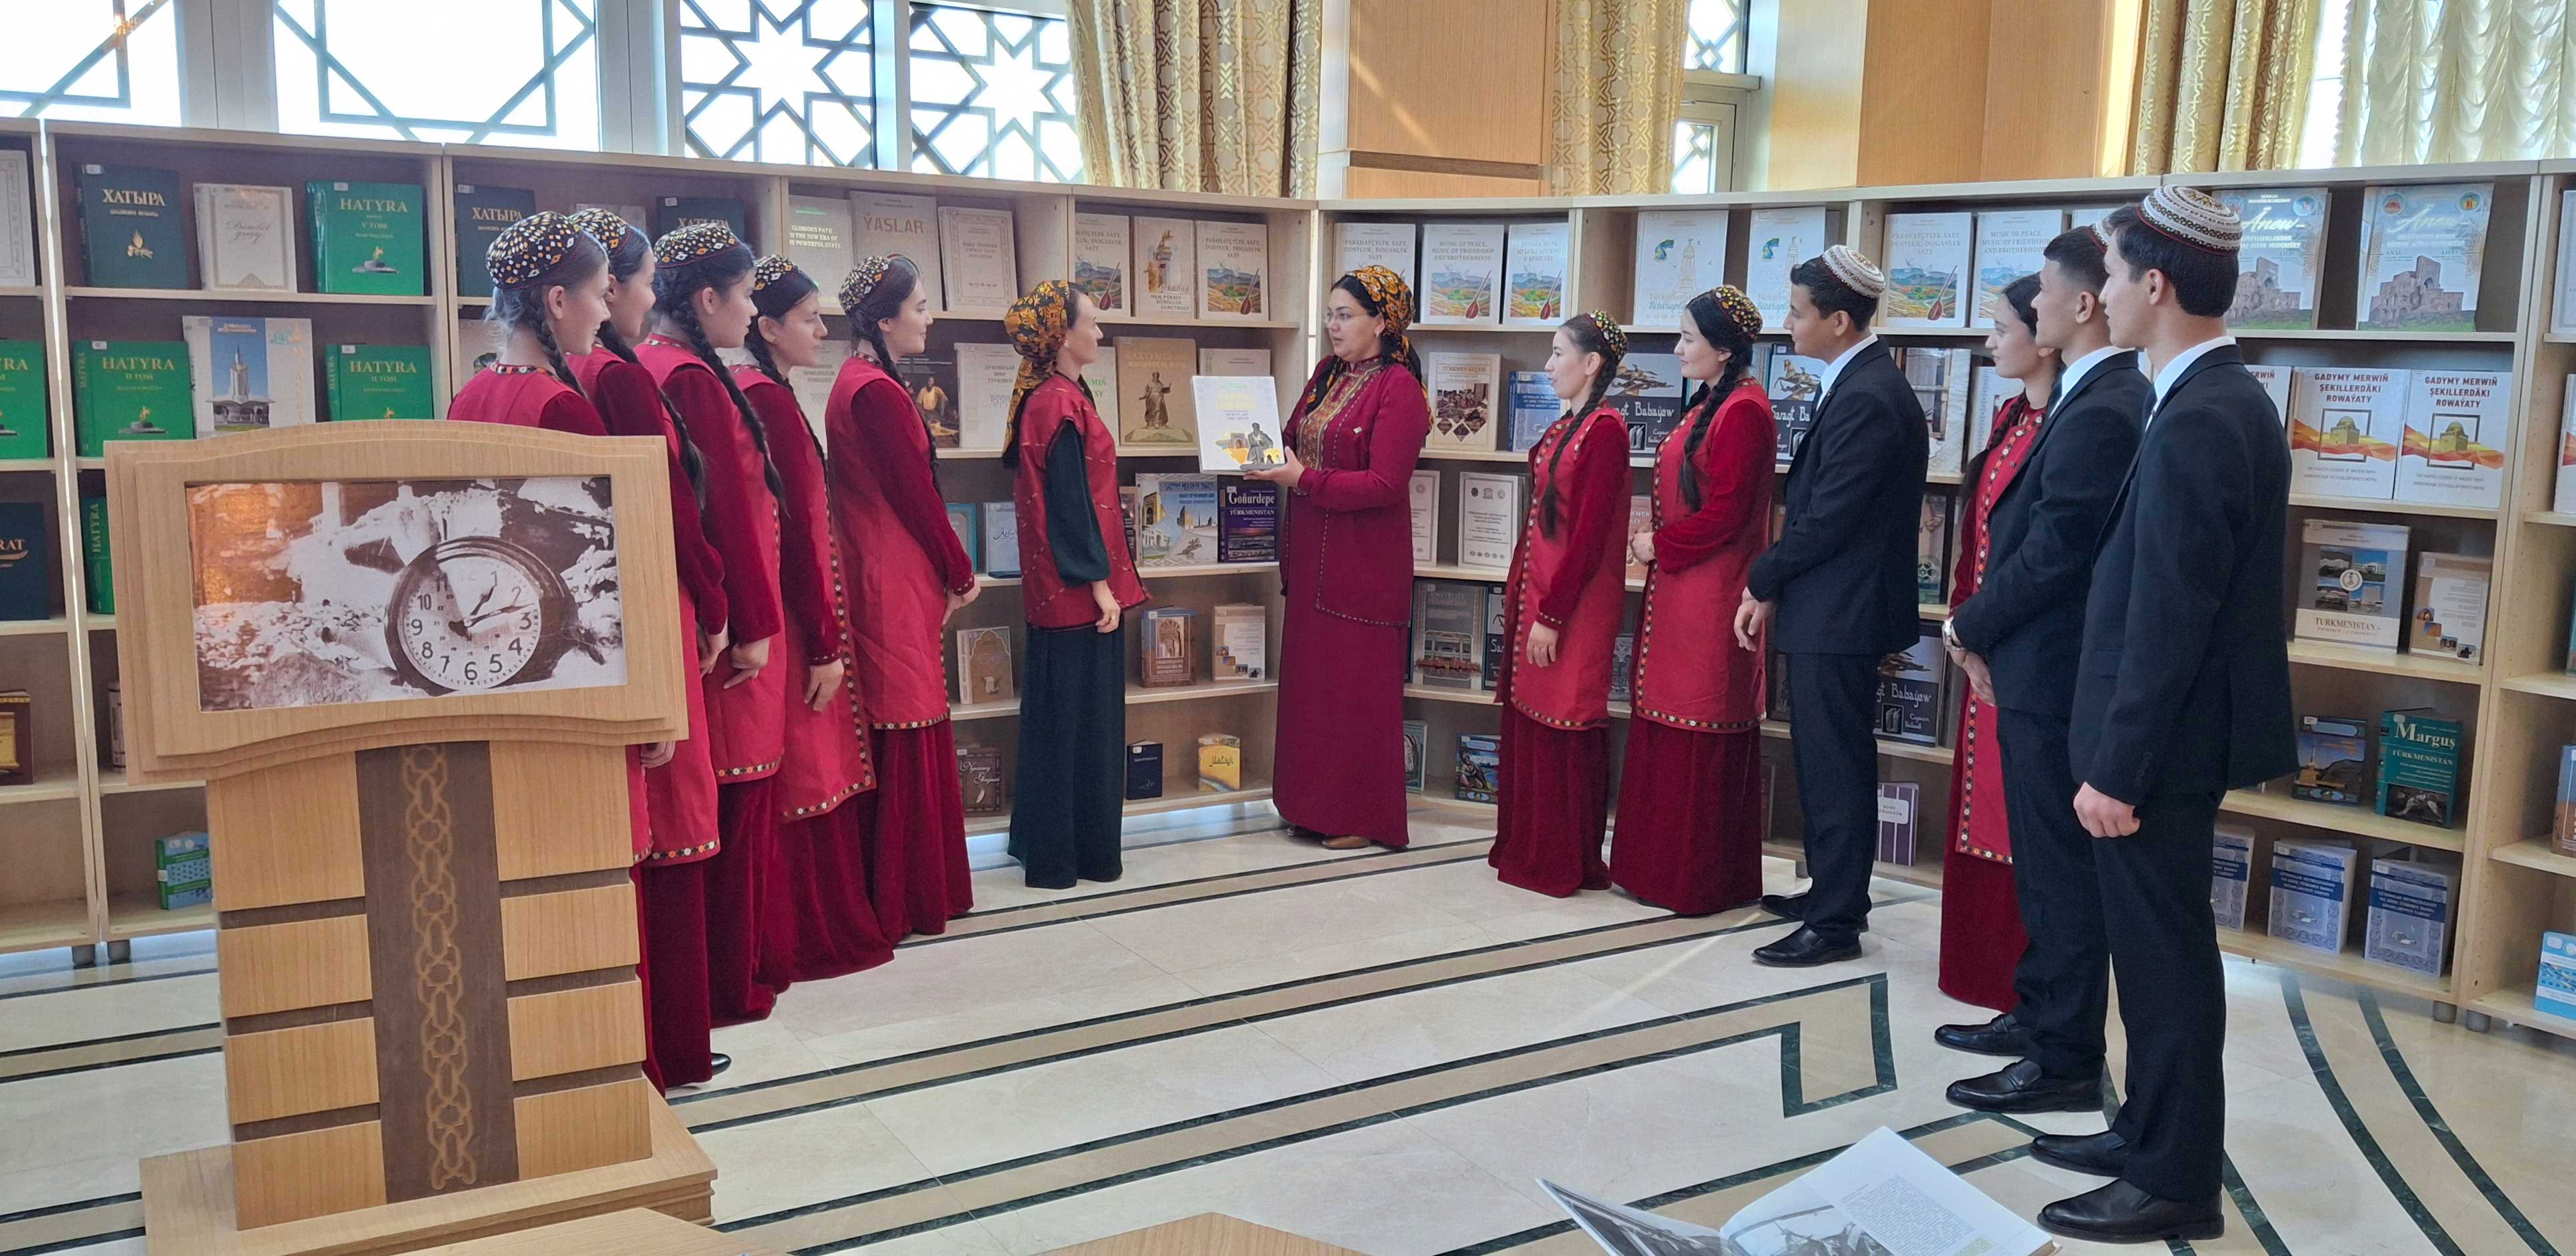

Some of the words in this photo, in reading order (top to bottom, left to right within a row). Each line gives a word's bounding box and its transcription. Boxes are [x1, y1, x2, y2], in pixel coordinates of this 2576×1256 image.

[102, 189, 165, 206] ХАТЫРА
[340, 199, 409, 213] HATYRA
[102, 357, 175, 371] HATYRA
[349, 360, 417, 374] HATYRA
[2315, 373, 2351, 381] GADYMY
[2353, 373, 2389, 382] MERWIŇ
[2425, 376, 2460, 385] GADYMY
[2463, 376, 2498, 387] MERWIŇ
[2319, 383, 2381, 393] ŞEKILLERDÄKI
[2429, 387, 2491, 397] ŞEKILLERDÄKI
[2326, 393, 2372, 403] ROWAÝATY
[2435, 397, 2481, 408] ROWAÝATY
[1228, 491, 1275, 507] Goňurdepe
[89, 503, 101, 553] HATYRA
[491, 570, 498, 587] 1
[417, 593, 432, 611] 10
[511, 586, 522, 606] 2
[411, 619, 423, 636] 9
[519, 611, 532, 631] 3
[421, 641, 433, 659] 8
[507, 637, 523, 657] 4
[440, 655, 451, 674] 7
[464, 661, 478, 681] 6
[489, 653, 503, 674] 5
[2394, 722, 2457, 751] Marguş
